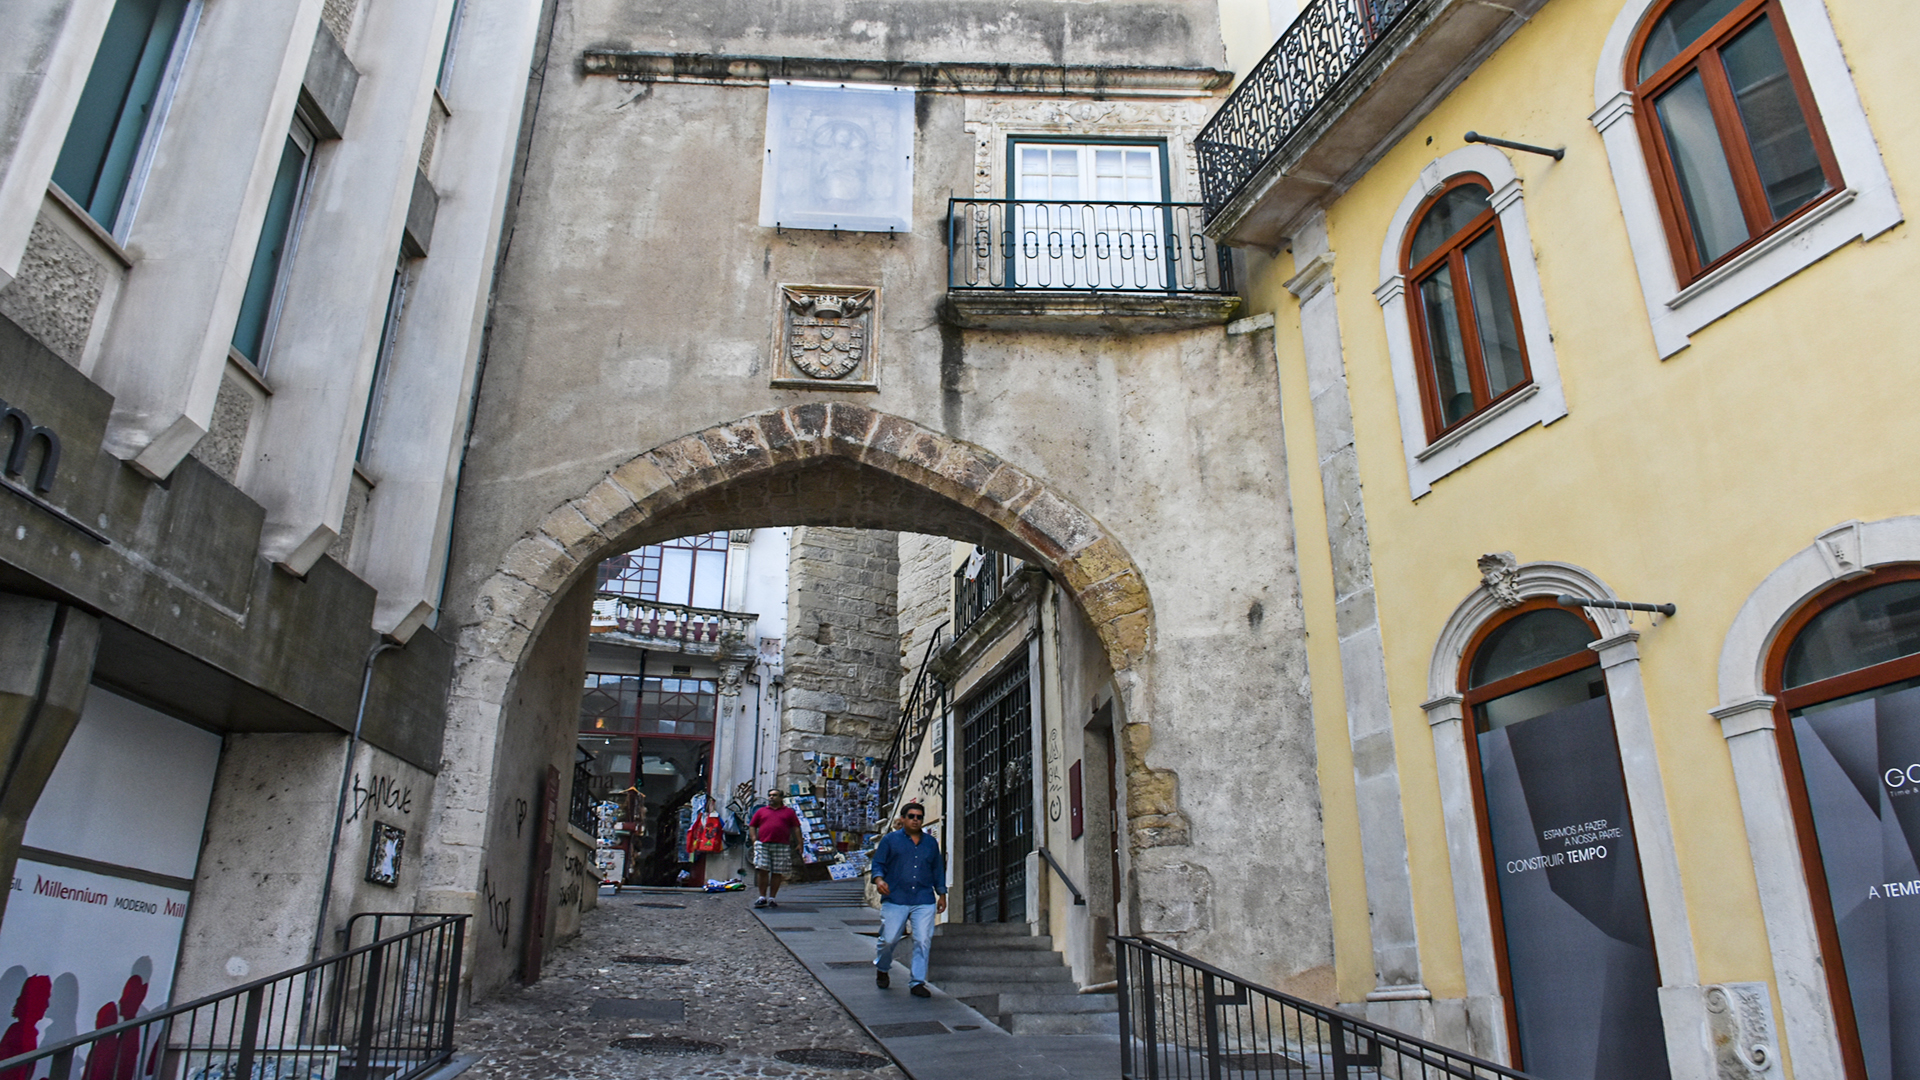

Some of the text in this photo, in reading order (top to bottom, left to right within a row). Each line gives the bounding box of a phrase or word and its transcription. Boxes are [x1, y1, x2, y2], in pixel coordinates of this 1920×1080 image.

[1543, 819, 1608, 840] ESTAMOS A FAZER
[1564, 837, 1572, 847] A
[1572, 832, 1599, 846] NOSSA
[1506, 845, 1608, 874] CONSTRUIR TEMPO
[33, 873, 109, 906] Millennium
[114, 897, 157, 915] MODERNO
[163, 897, 187, 918] Mill
[1868, 885, 1881, 900] A
